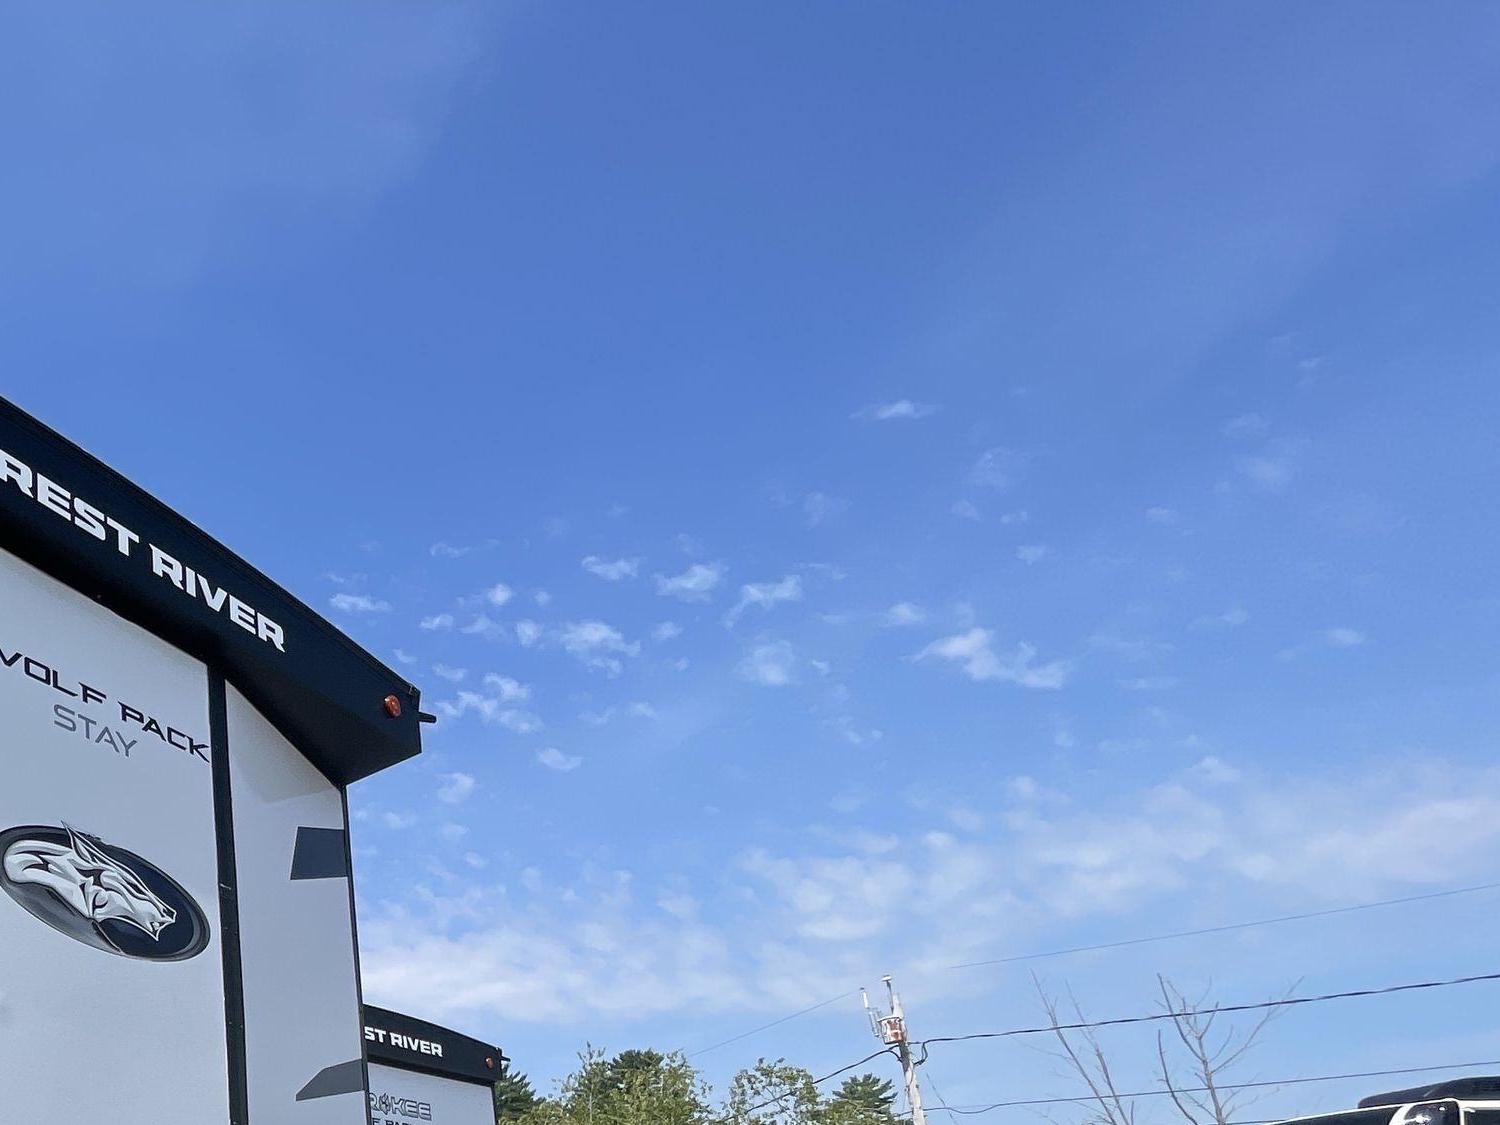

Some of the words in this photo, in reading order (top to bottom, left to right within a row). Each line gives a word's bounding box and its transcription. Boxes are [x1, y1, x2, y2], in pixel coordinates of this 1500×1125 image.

[148, 541, 287, 653] RIVER
[52, 703, 138, 758] STAY
[117, 700, 211, 764] PACK
[389, 1032, 444, 1058] RIVER
